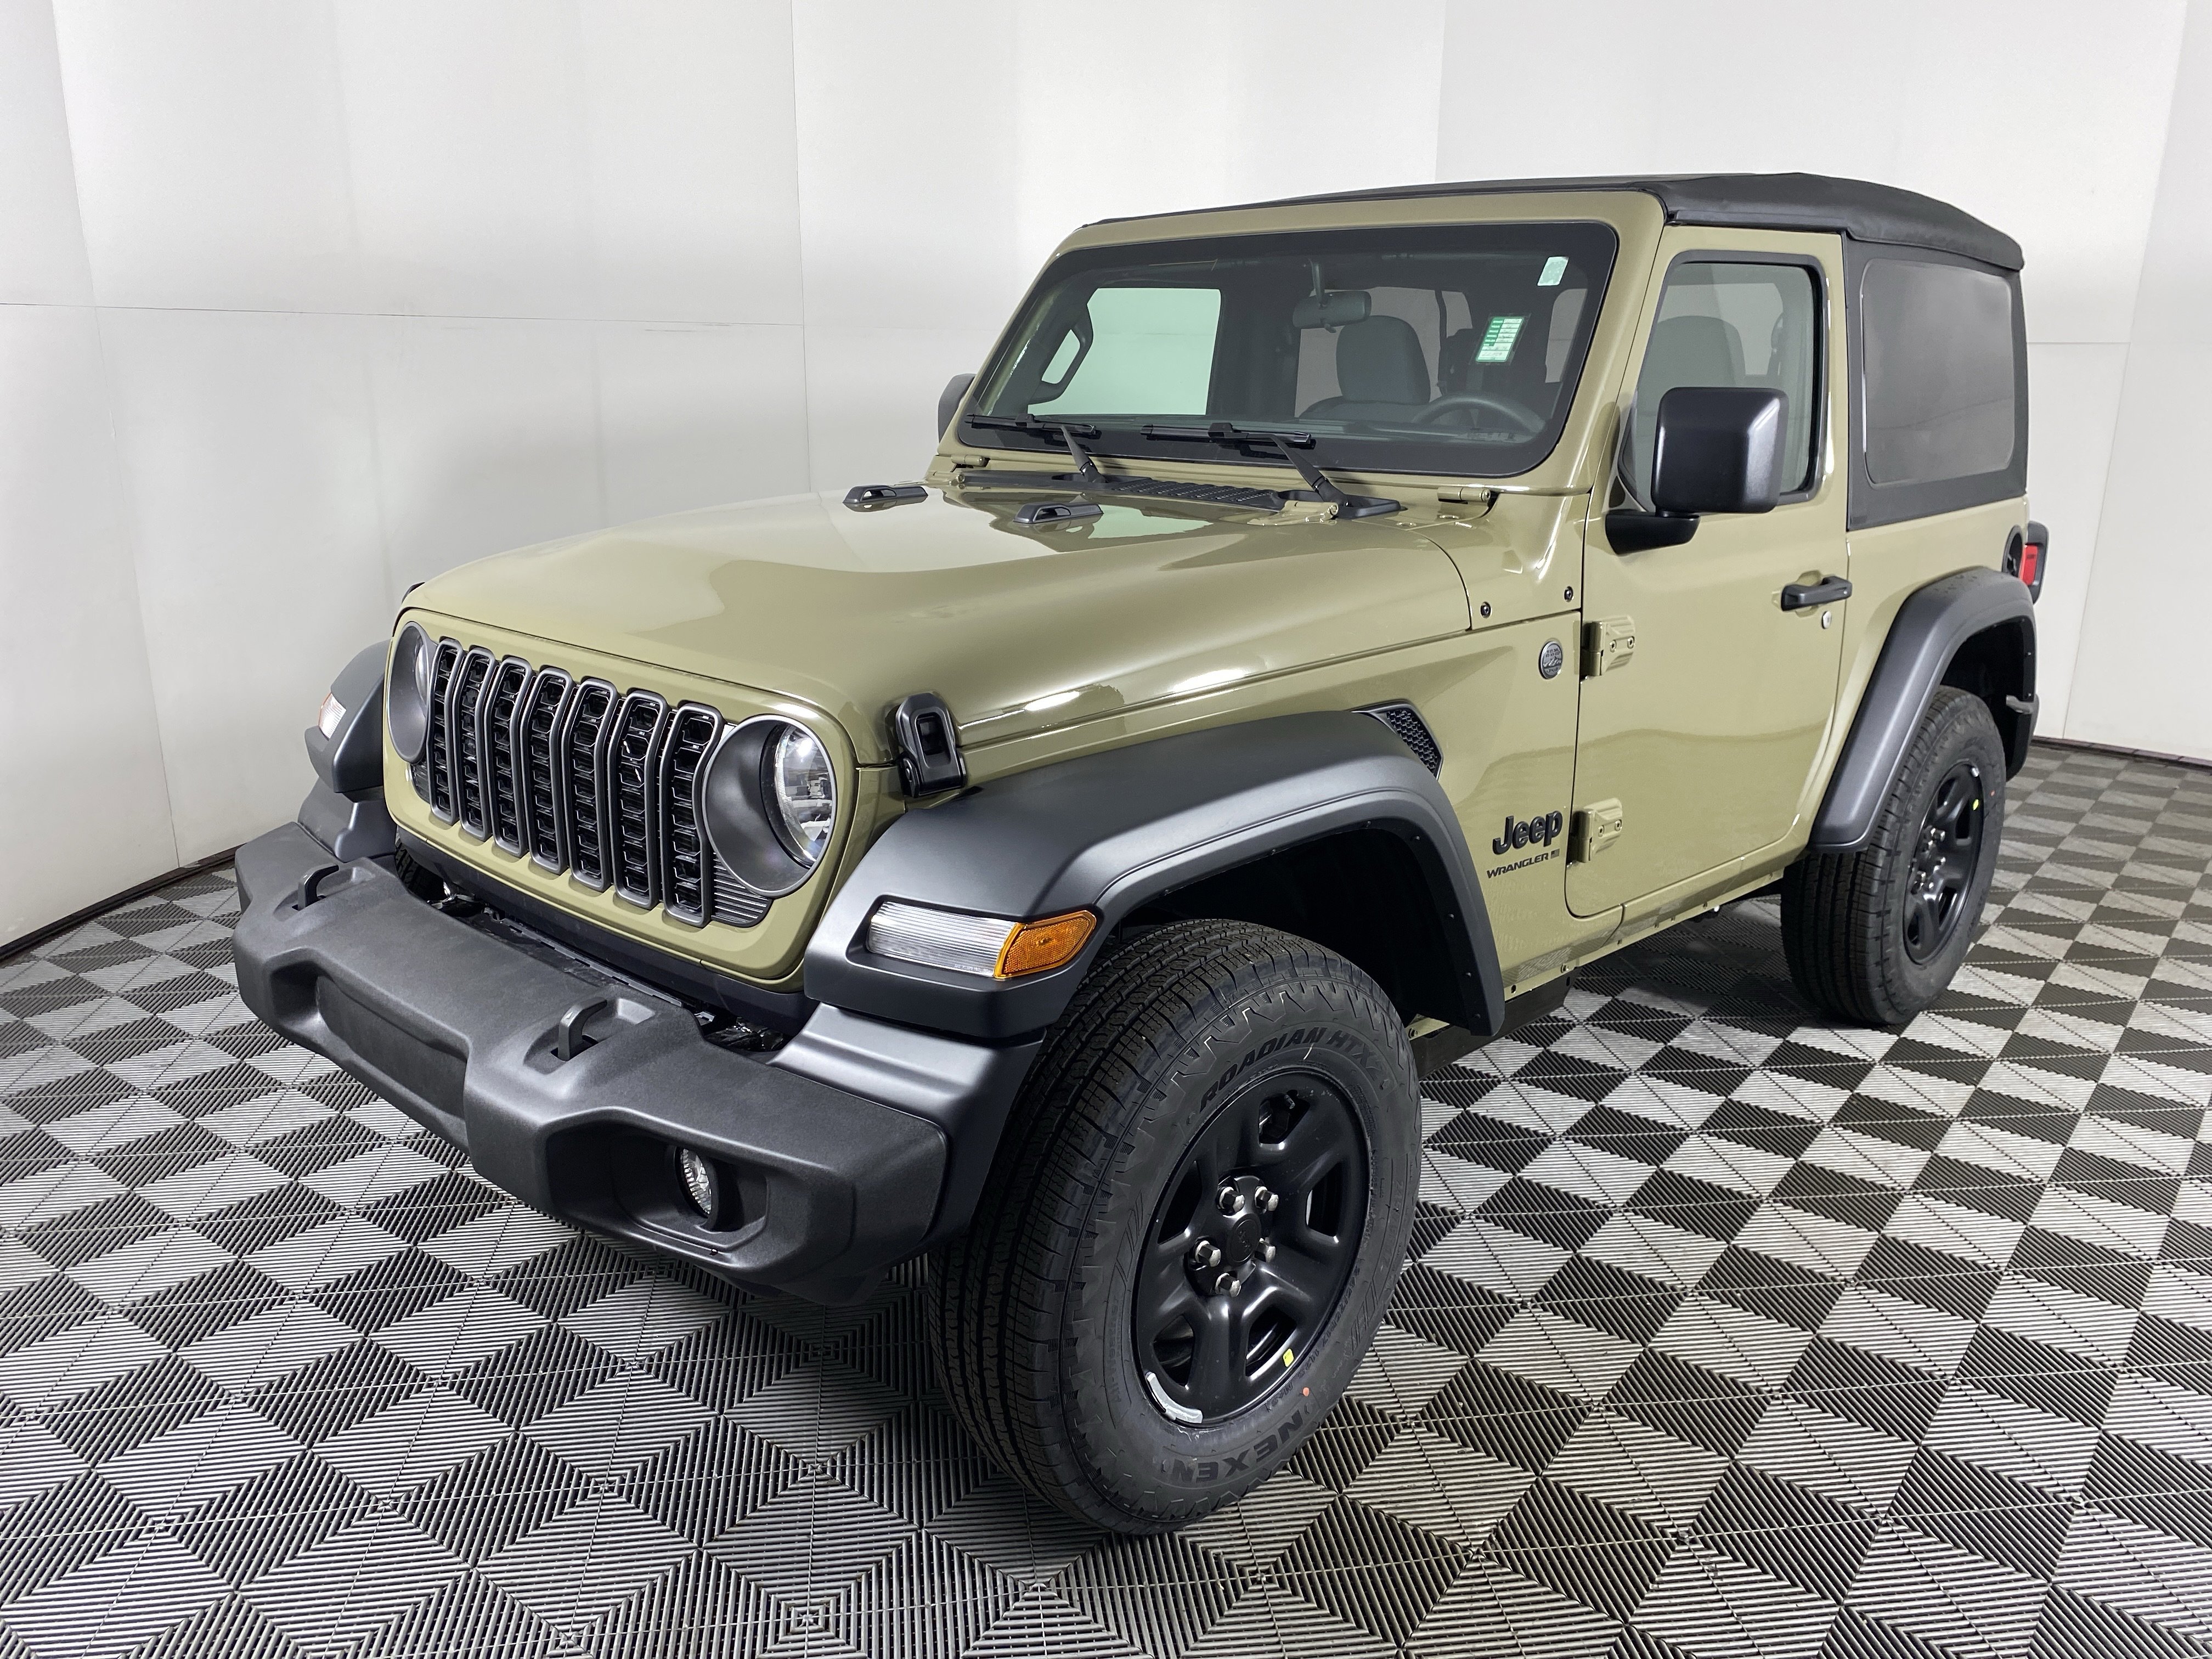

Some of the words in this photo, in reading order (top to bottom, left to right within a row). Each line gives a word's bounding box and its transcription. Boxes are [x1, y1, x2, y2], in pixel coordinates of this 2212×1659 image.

[1492, 810, 1563, 855] Jeep
[1486, 853, 1549, 878] WRANGLER
[1200, 1026, 1328, 1114] ROADIAN
[1172, 1409, 1304, 1483] NEXEN
